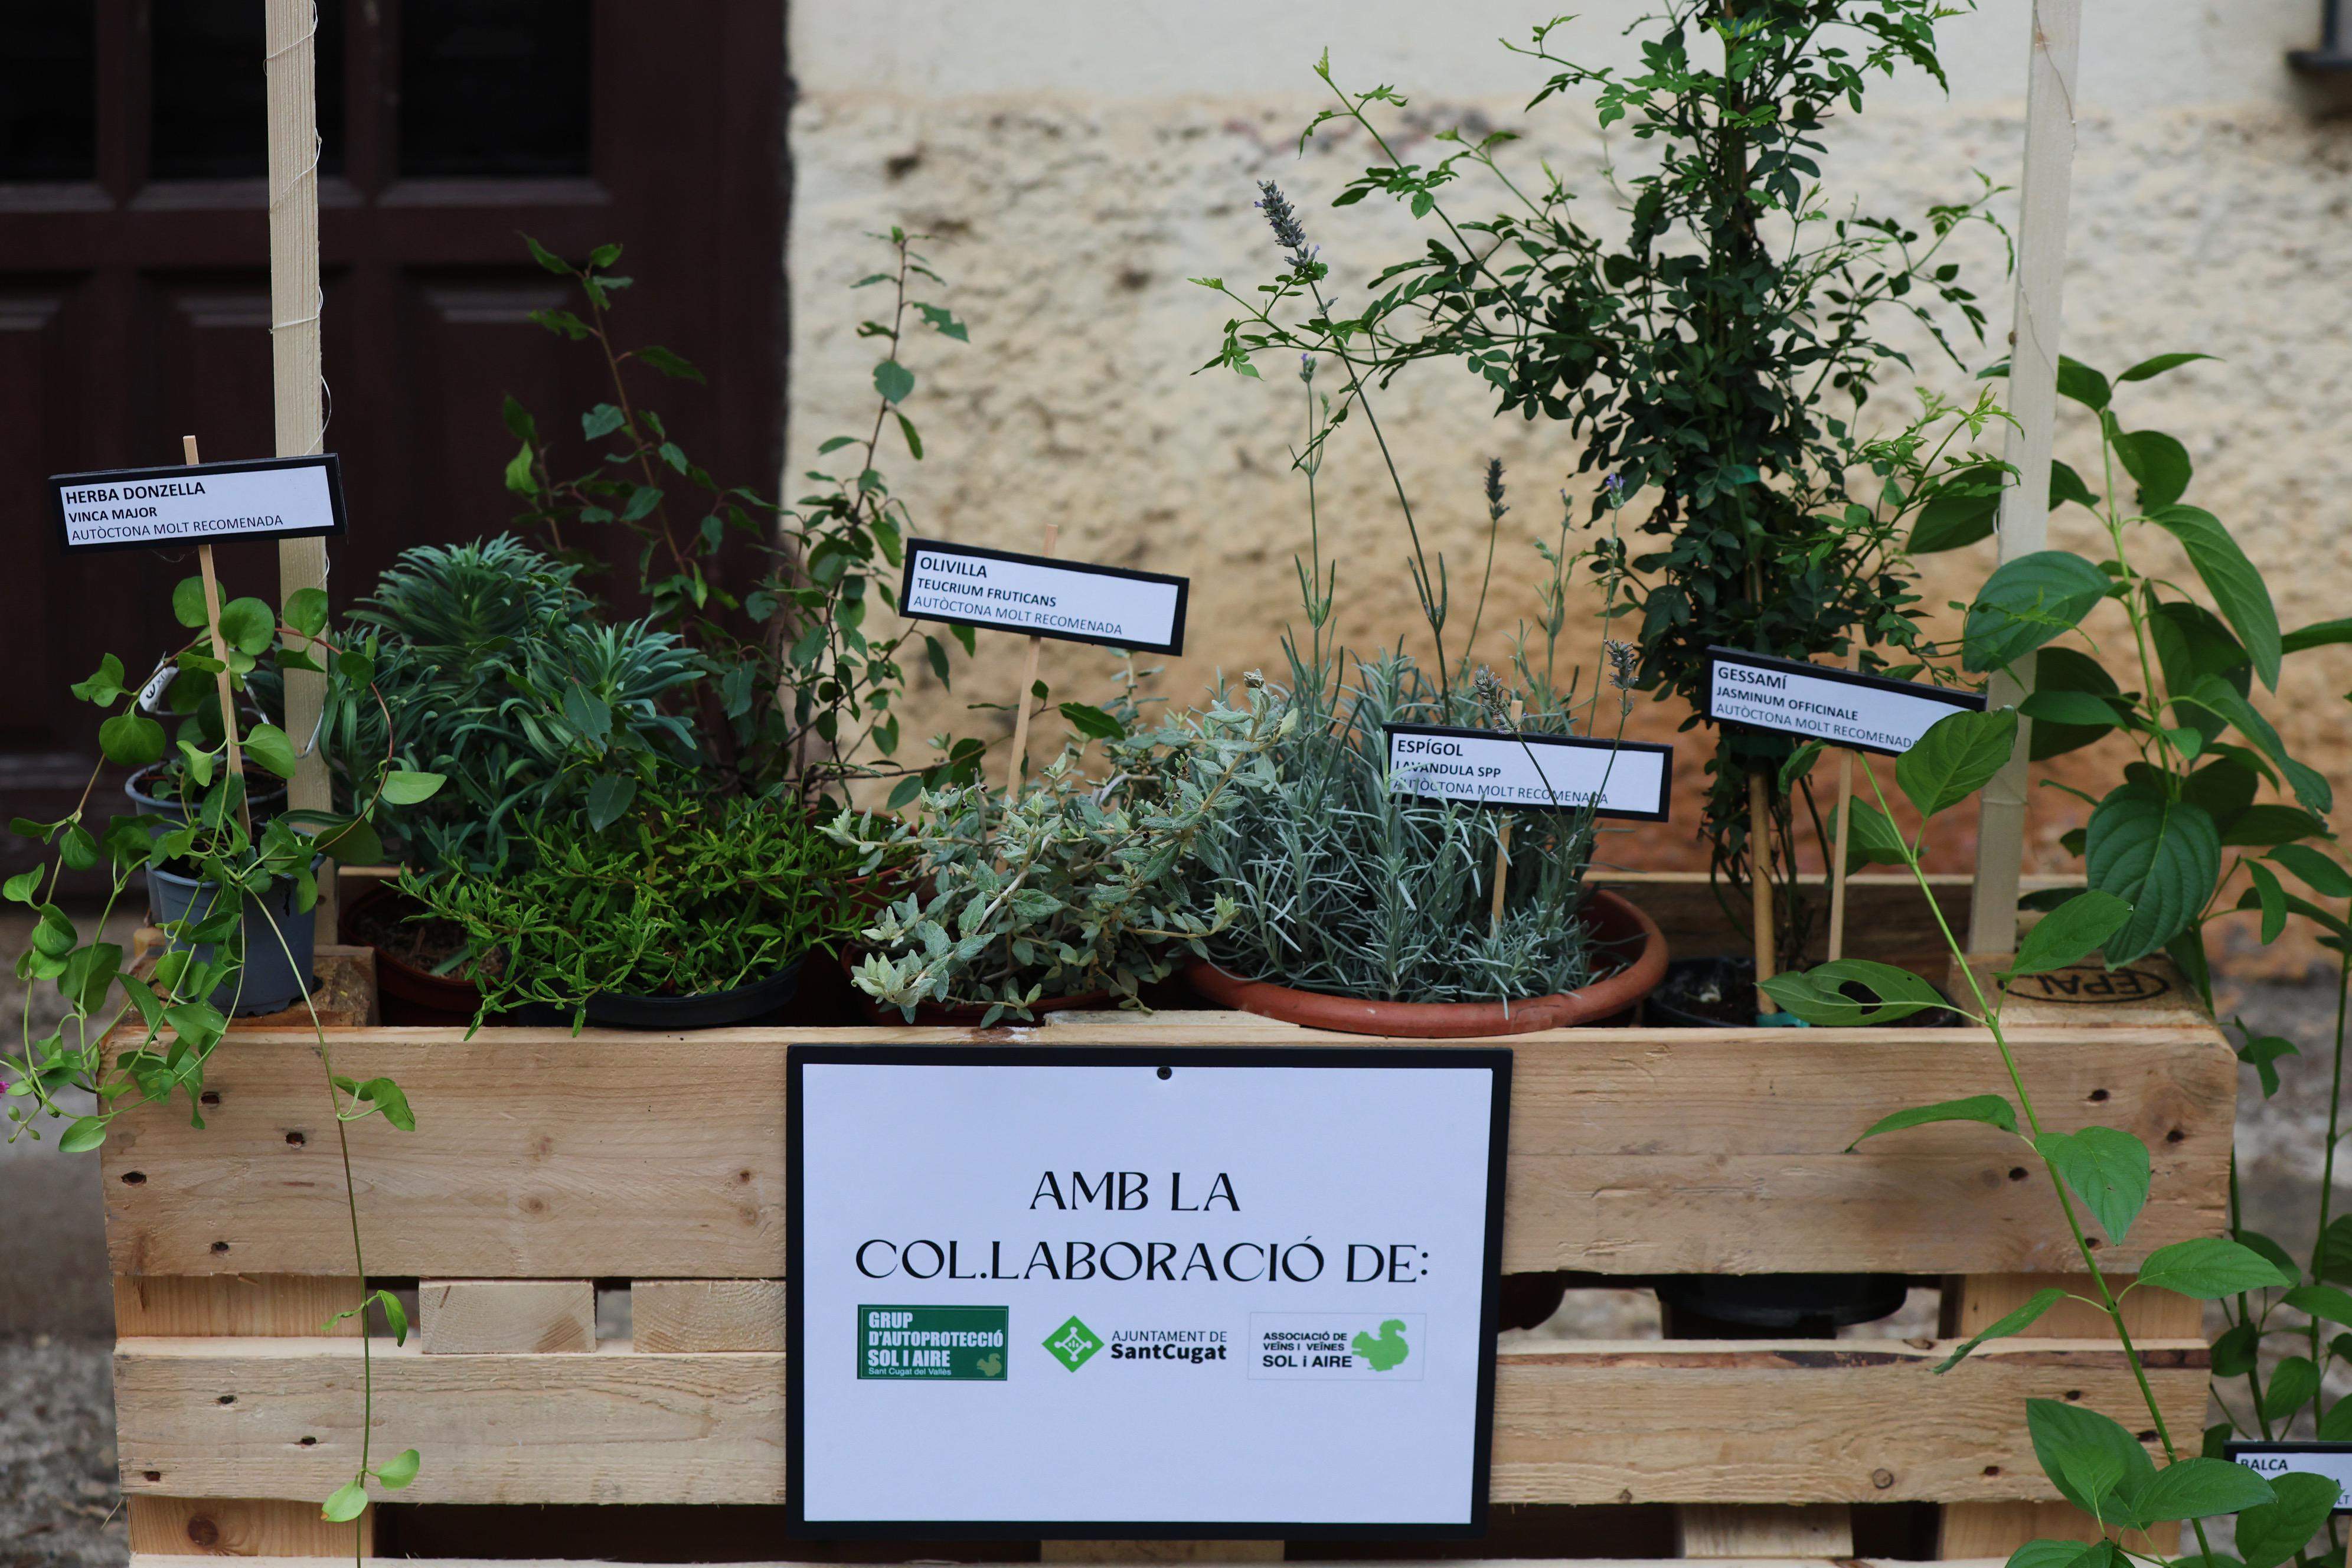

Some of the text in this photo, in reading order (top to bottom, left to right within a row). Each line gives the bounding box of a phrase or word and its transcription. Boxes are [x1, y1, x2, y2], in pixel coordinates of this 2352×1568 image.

[66, 482, 206, 504] HERBA DONZELLA
[68, 507, 158, 523] VINCA MAJOR
[71, 515, 283, 541] AUTÒCTONA MOLT RECOMENADA
[920, 557, 988, 578] OLIVILLA
[917, 577, 1057, 607] TEUCRIUM FRUTICANS
[913, 596, 1122, 635] AUTÒCTONA MOLT RECOMENADA
[1718, 666, 1788, 689] GESSAMÍ
[1717, 686, 1858, 721] JASMINUM OFFICINALE
[1716, 703, 1792, 725] AUTÒCTONA
[1795, 717, 1831, 733] MOLT
[1397, 738, 1464, 756] ESPÍGOL
[1477, 767, 1501, 778] SPP
[1478, 785, 1514, 796] MOLT
[1029, 1171, 1241, 1212] AMB LA
[855, 1235, 1429, 1283] COL.LABORACIÓ DE:
[868, 1312, 913, 1328] GRUP
[868, 1329, 1004, 1347] D'AUTOPROTECCIÓ
[1112, 1330, 1227, 1342] AJUNTAMENT DE
[1263, 1331, 1330, 1341] ASSOCIACIÓ
[868, 1350, 950, 1367] SOL I AIRE
[1111, 1343, 1227, 1364] SantCugat
[1263, 1355, 1298, 1367] SOL
[1311, 1355, 1353, 1368] AIRE
[868, 1367, 887, 1376] Sant
[888, 1367, 912, 1377] Cugat
